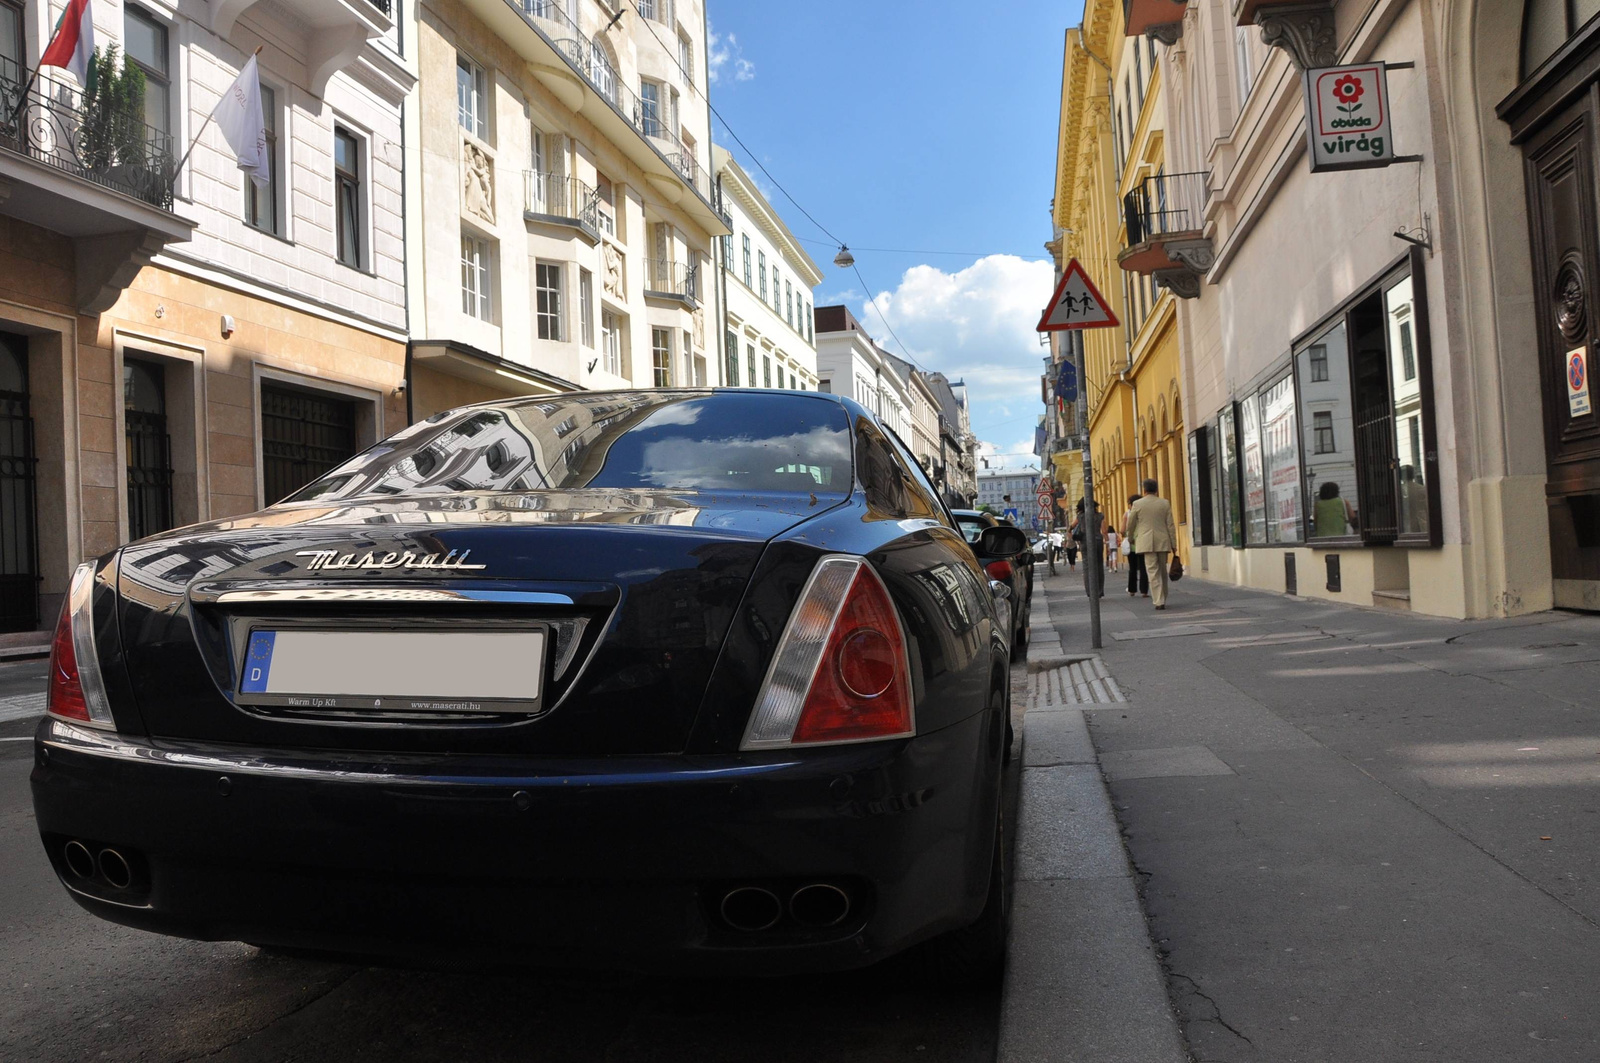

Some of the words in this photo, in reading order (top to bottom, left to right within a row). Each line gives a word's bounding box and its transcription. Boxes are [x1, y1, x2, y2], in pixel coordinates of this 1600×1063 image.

[1323, 133, 1384, 158] virág
[295, 548, 487, 571] Maserati
[251, 668, 262, 682] D
[288, 697, 310, 707] Warm
[312, 698, 323, 708] Up
[325, 698, 336, 707] Kft
[411, 701, 481, 710] www.maserati.hu
